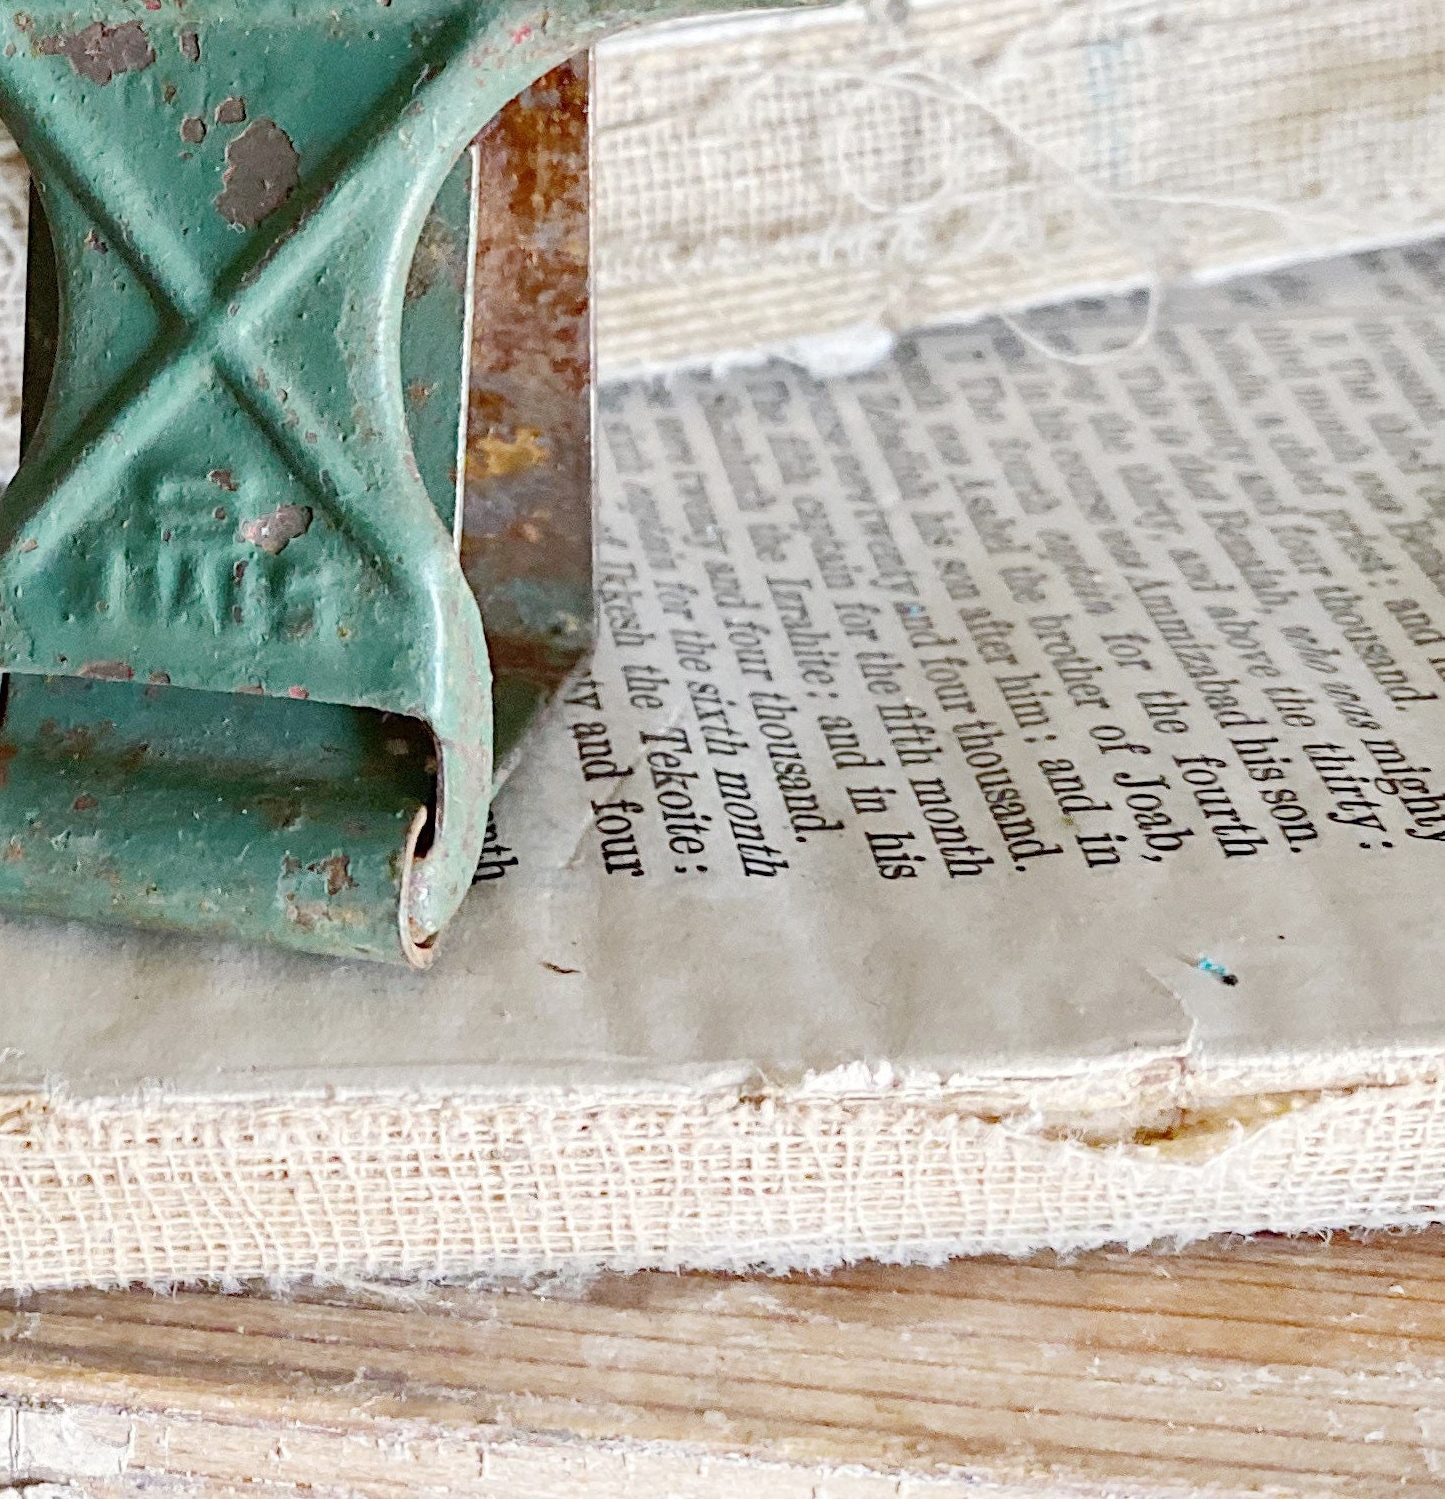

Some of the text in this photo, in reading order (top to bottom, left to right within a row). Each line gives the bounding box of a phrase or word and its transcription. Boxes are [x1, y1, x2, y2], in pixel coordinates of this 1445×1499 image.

[705, 557, 760, 607] and
[725, 618, 773, 681] four
[834, 602, 880, 641] for
[1314, 585, 1437, 711] thousand.
[1383, 598, 1445, 645] and
[621, 663, 670, 710] the
[857, 651, 902, 696] the
[1027, 612, 1111, 710] brother
[572, 721, 634, 781] and
[654, 579, 789, 879] for the sixth month
[818, 714, 885, 770] and
[879, 702, 943, 766] fifth
[959, 606, 1019, 666] after
[995, 673, 1057, 743] him:
[1038, 758, 1111, 816] and
[1076, 832, 1128, 868] in
[1089, 724, 1152, 755] of
[1100, 632, 1152, 671] for
[1136, 689, 1189, 735] the
[1173, 755, 1268, 858] fourth
[1127, 575, 1320, 853] Ammizabad his son.
[1205, 605, 1280, 678] above
[1262, 684, 1316, 728] the
[1302, 742, 1393, 850] thirty:
[1282, 626, 1340, 673] who
[1320, 680, 1381, 729] was
[1361, 737, 1445, 841] mighty
[747, 690, 844, 844] thousand.
[846, 785, 896, 815] in
[921, 655, 974, 712] four
[953, 719, 1063, 872] thousand.
[590, 800, 644, 878] four
[865, 831, 927, 881] his
[910, 778, 994, 878] month
[1113, 771, 1193, 863] Joab,
